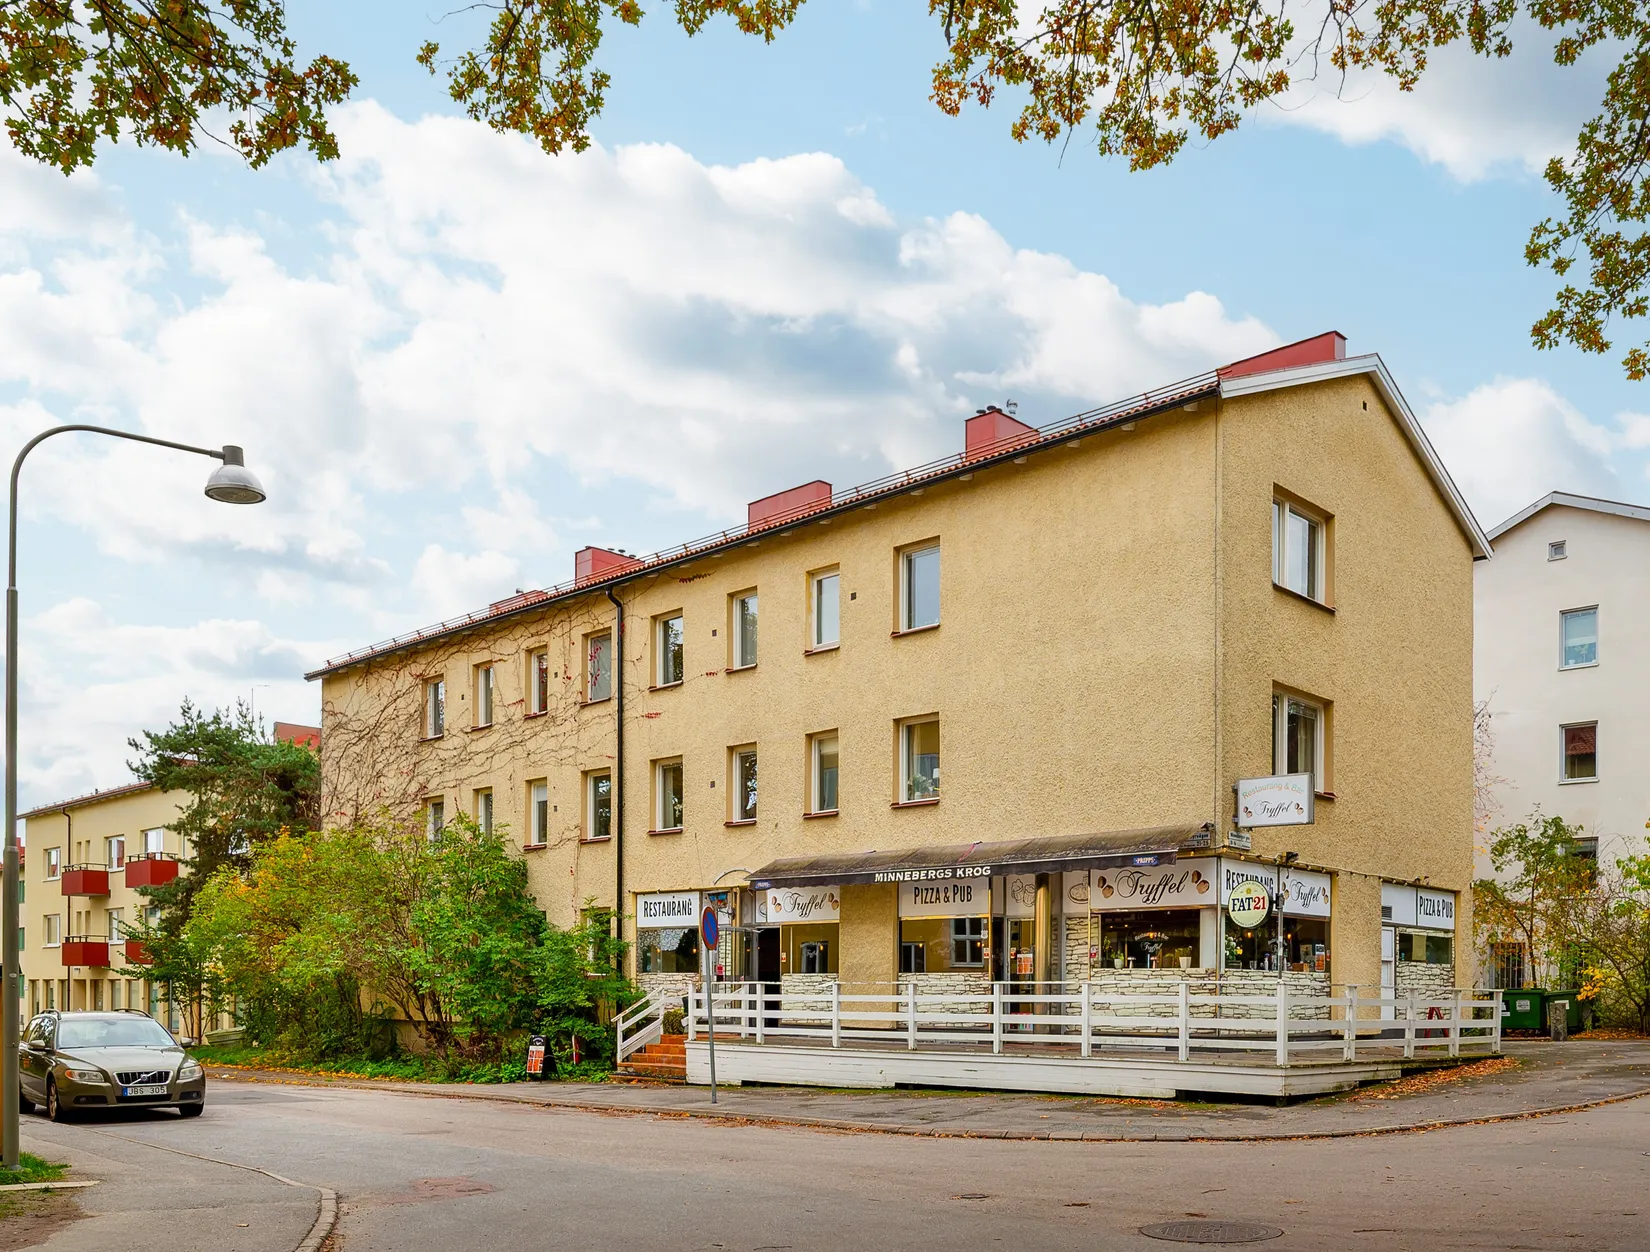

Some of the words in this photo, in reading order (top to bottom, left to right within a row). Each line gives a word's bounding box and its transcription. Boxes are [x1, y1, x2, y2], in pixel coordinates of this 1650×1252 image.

[1242, 782, 1283, 800] Restaurang
[1284, 782, 1290, 791] &
[1291, 783, 1305, 795] Bar
[1253, 800, 1293, 819] Tryffel
[874, 869, 953, 883] MINNEBERGS
[956, 866, 992, 879] KROG
[913, 886, 942, 905] PIZZA
[943, 887, 951, 903] &
[952, 883, 973, 904] PUB
[1115, 869, 1190, 905] Tryffel
[1290, 878, 1322, 909] Tryffel
[643, 899, 692, 918] RESTAURANG
[782, 891, 828, 918] Tryffel
[1231, 895, 1267, 912] FAT21
[1419, 895, 1436, 917] PIZZA
[1436, 902, 1441, 917] &
[1442, 897, 1453, 919] PUB
[128, 1086, 144, 1095] JBS
[150, 1086, 166, 1094] 305
